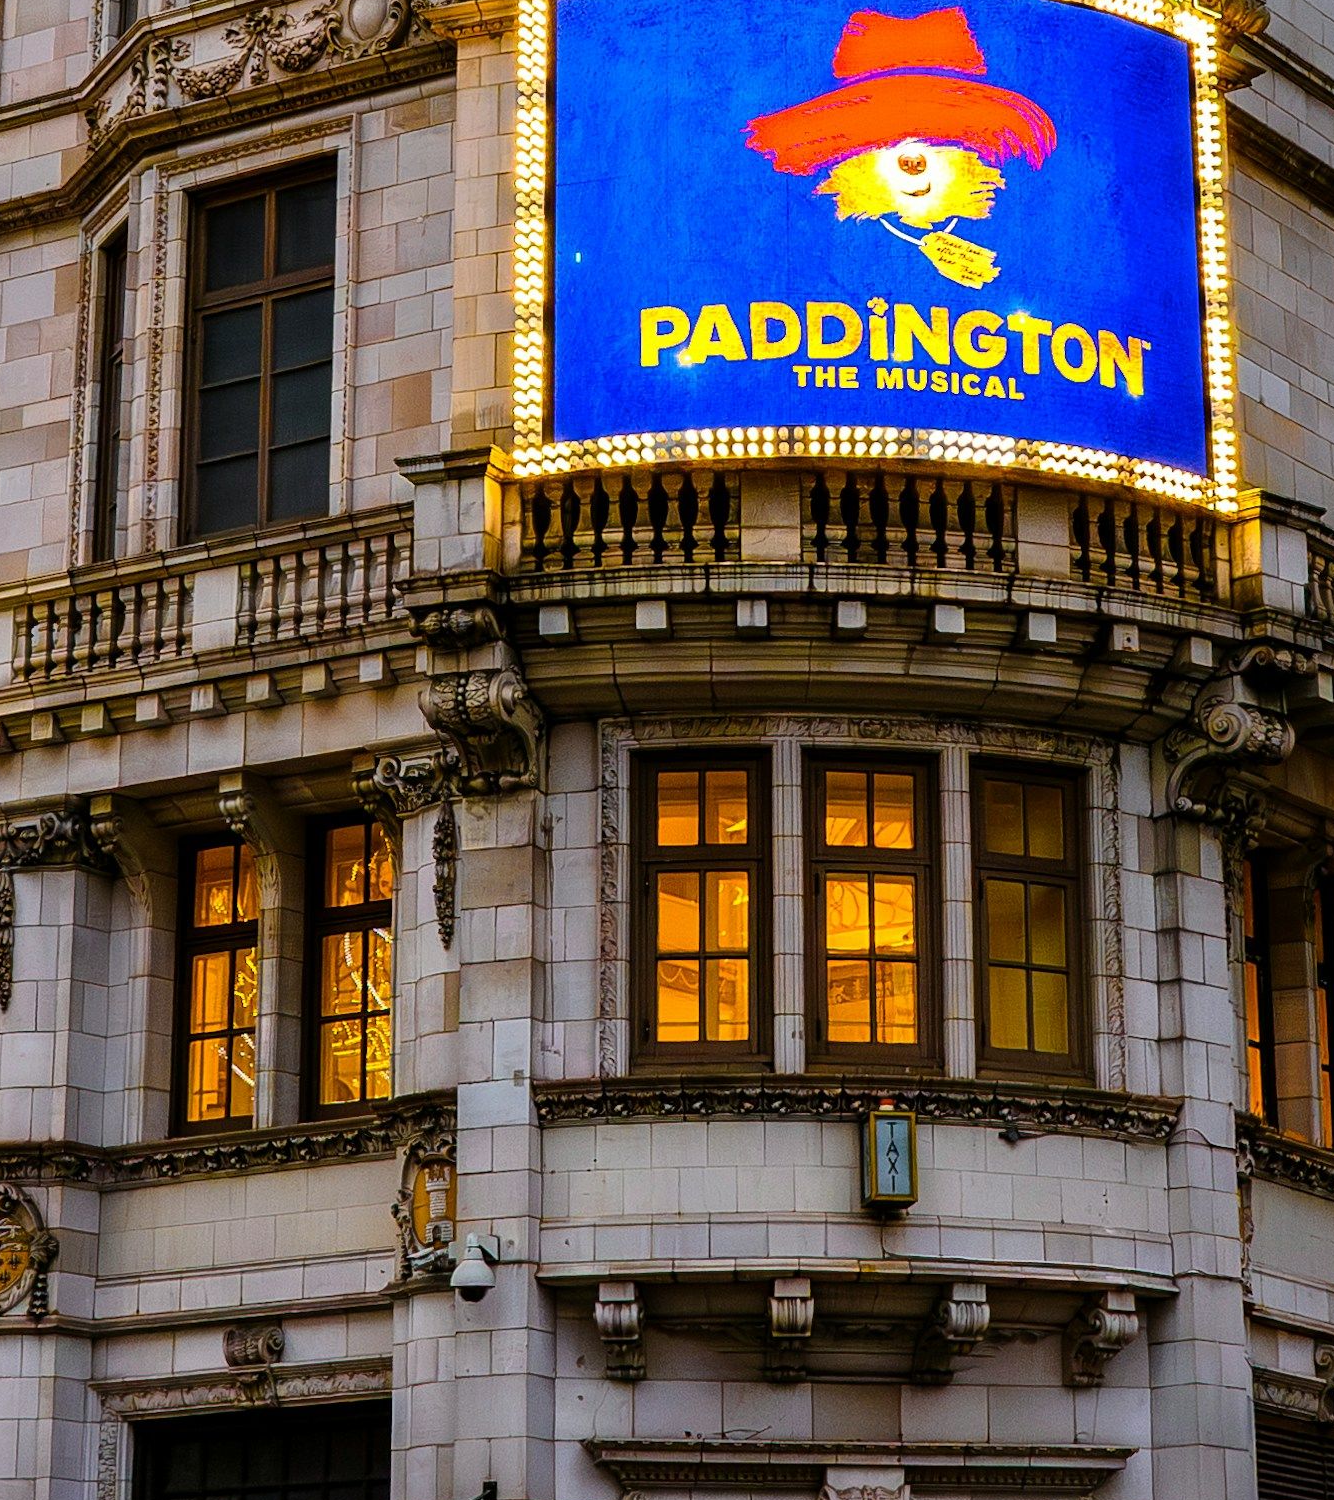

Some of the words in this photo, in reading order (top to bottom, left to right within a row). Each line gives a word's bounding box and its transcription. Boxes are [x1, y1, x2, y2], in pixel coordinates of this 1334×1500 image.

[793, 365, 860, 390] THE
[876, 367, 1025, 401] MUSICAL
[885, 1121, 900, 1193] TAXI
